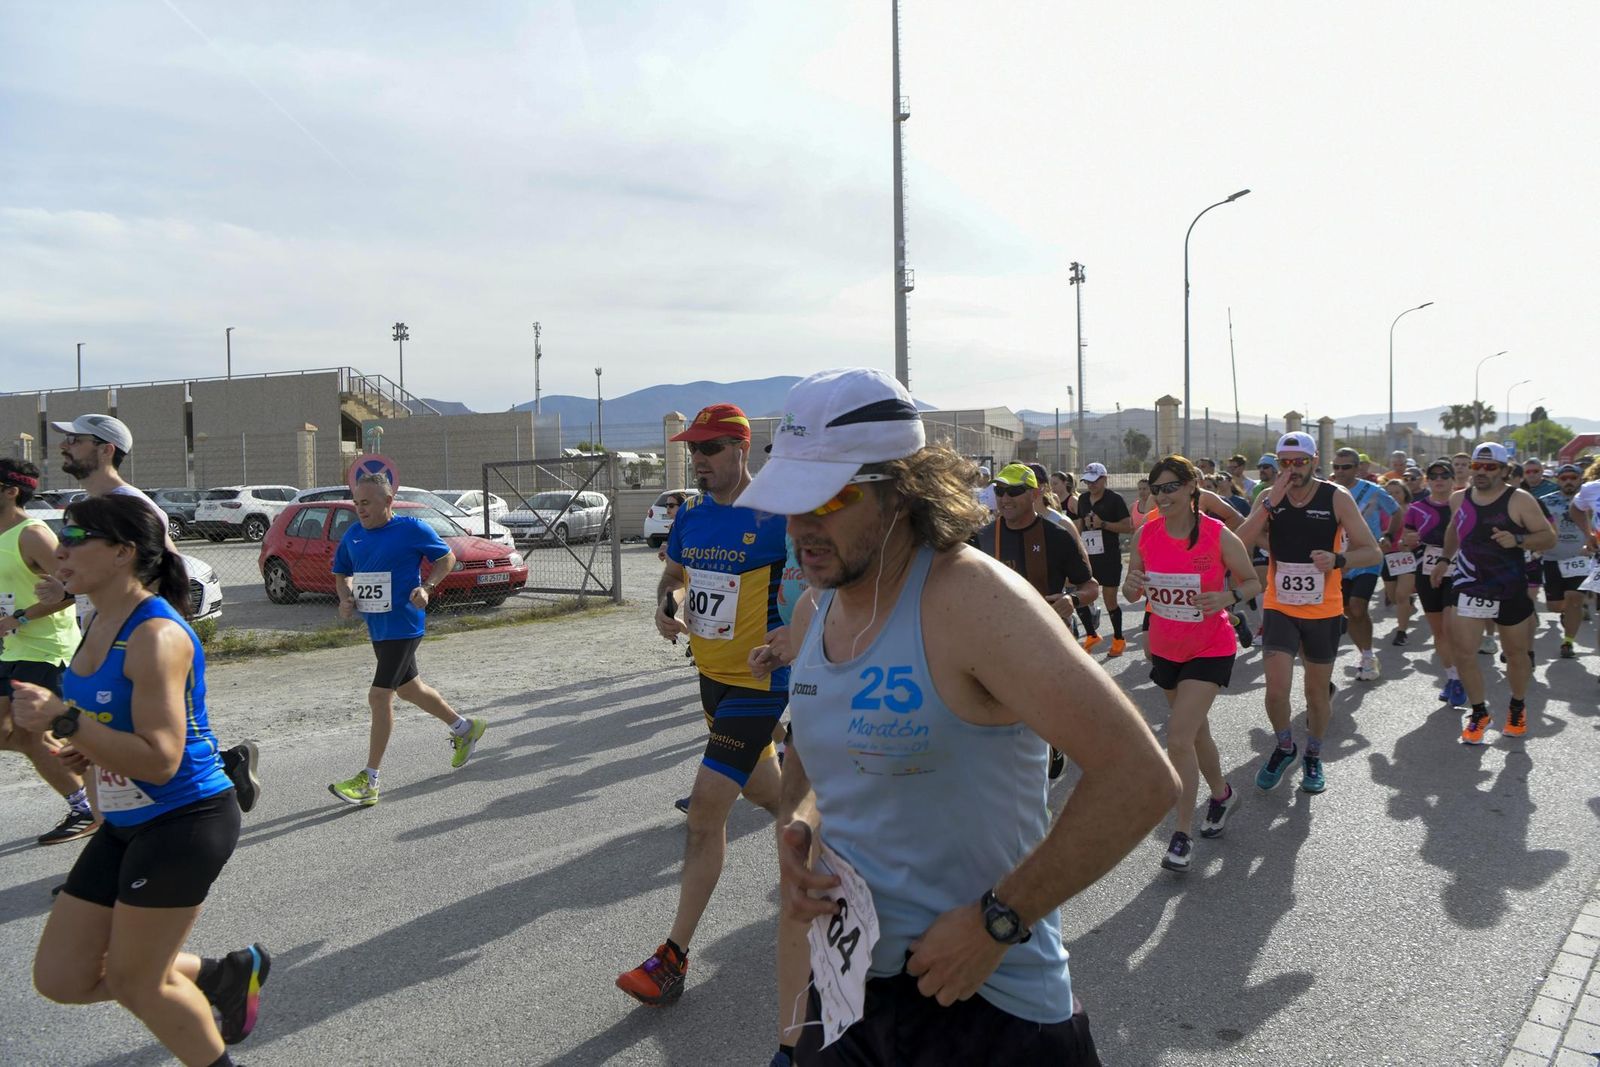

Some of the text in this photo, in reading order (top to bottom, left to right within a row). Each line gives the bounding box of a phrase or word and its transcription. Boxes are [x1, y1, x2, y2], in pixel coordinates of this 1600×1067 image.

[1085, 538, 1095, 547] 11
[681, 545, 746, 564] agustinos
[1389, 556, 1414, 568] 2145
[1563, 560, 1585, 570] 765
[1282, 575, 1315, 591] 833
[357, 585, 383, 600] 225
[1148, 587, 1198, 606] 2028
[689, 589, 725, 617] 807
[1466, 596, 1495, 608] 793
[850, 665, 924, 714] 25
[847, 715, 930, 738] Maratón
[710, 732, 746, 749] gustinos
